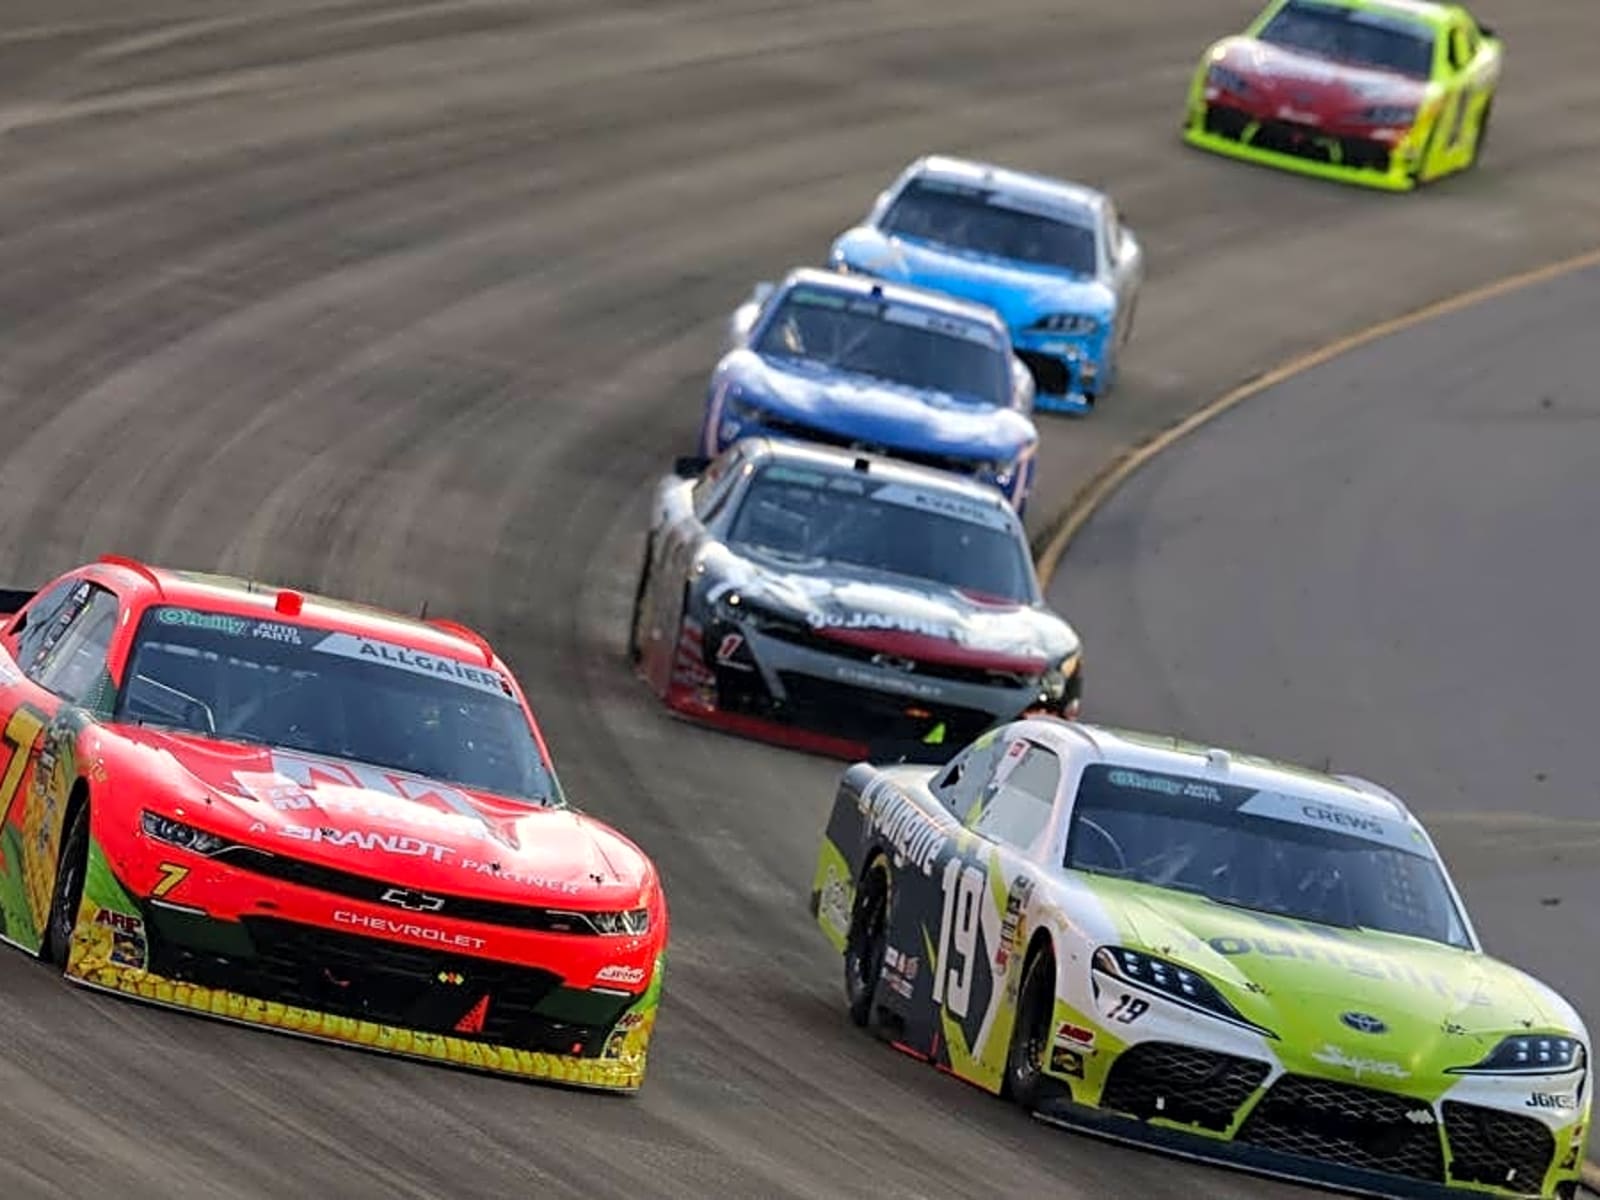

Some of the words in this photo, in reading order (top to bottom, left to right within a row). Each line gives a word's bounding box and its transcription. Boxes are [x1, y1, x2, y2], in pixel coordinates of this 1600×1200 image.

[252, 629, 303, 645] PARTS
[257, 622, 299, 637] AUTO
[360, 642, 500, 688] ALLGAIER
[1302, 805, 1385, 835] CREWS
[249, 822, 268, 834] A
[277, 823, 457, 862] BRANDT
[460, 858, 581, 896] PARTNER
[151, 862, 190, 897] 7
[332, 909, 487, 949] CHEVROLET
[931, 857, 989, 1019] 19
[1106, 994, 1150, 1025] 19
